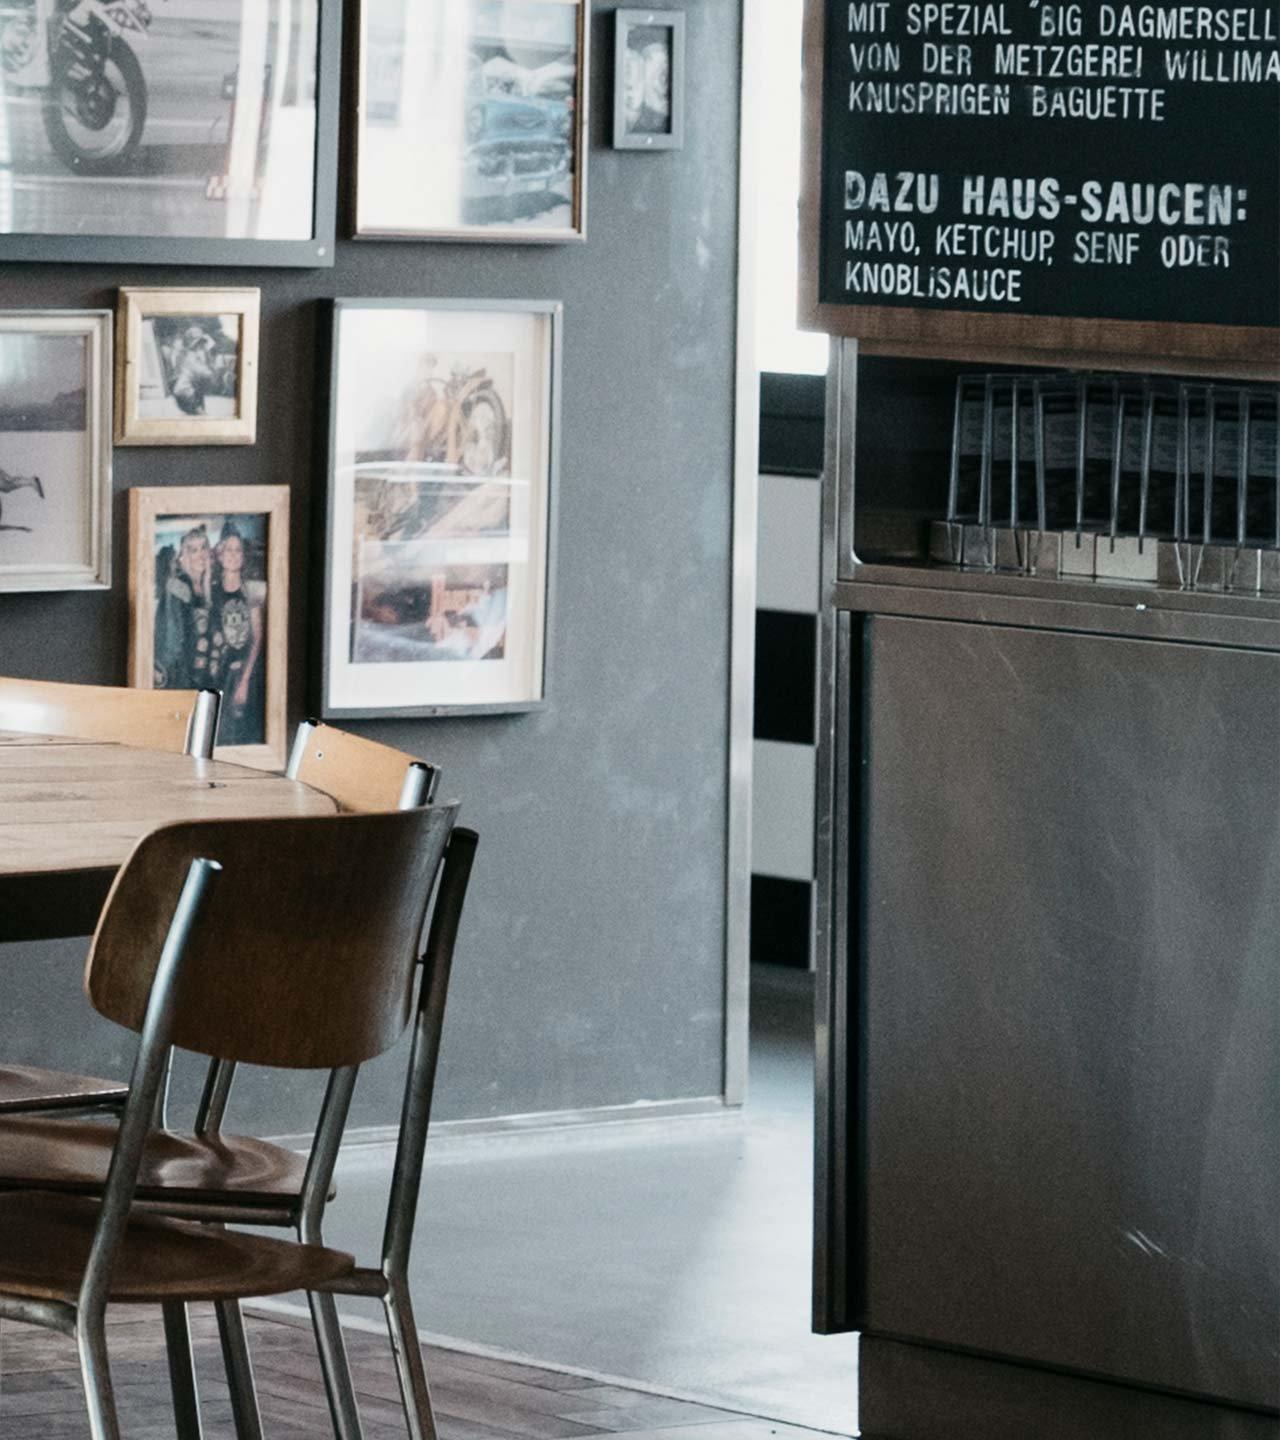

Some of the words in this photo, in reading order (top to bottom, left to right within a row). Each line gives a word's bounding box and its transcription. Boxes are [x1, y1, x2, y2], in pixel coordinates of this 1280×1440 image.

[848, 2, 890, 33] MIT
[906, 2, 1013, 36] SPEZIAL
[850, 41, 900, 73] VON
[922, 42, 972, 77] DER
[994, 43, 1143, 78] METZGEREI
[849, 80, 1010, 116] KNUSPRIGEN
[1032, 85, 1165, 121] BAGUETTE
[844, 170, 939, 214] DAZU
[962, 174, 1248, 227] HAUS-SAUCEN:
[845, 220, 920, 256] MAYO,
[936, 223, 1056, 266] KETCHUP,
[1073, 231, 1140, 265] SENF
[1160, 234, 1230, 269] ODER
